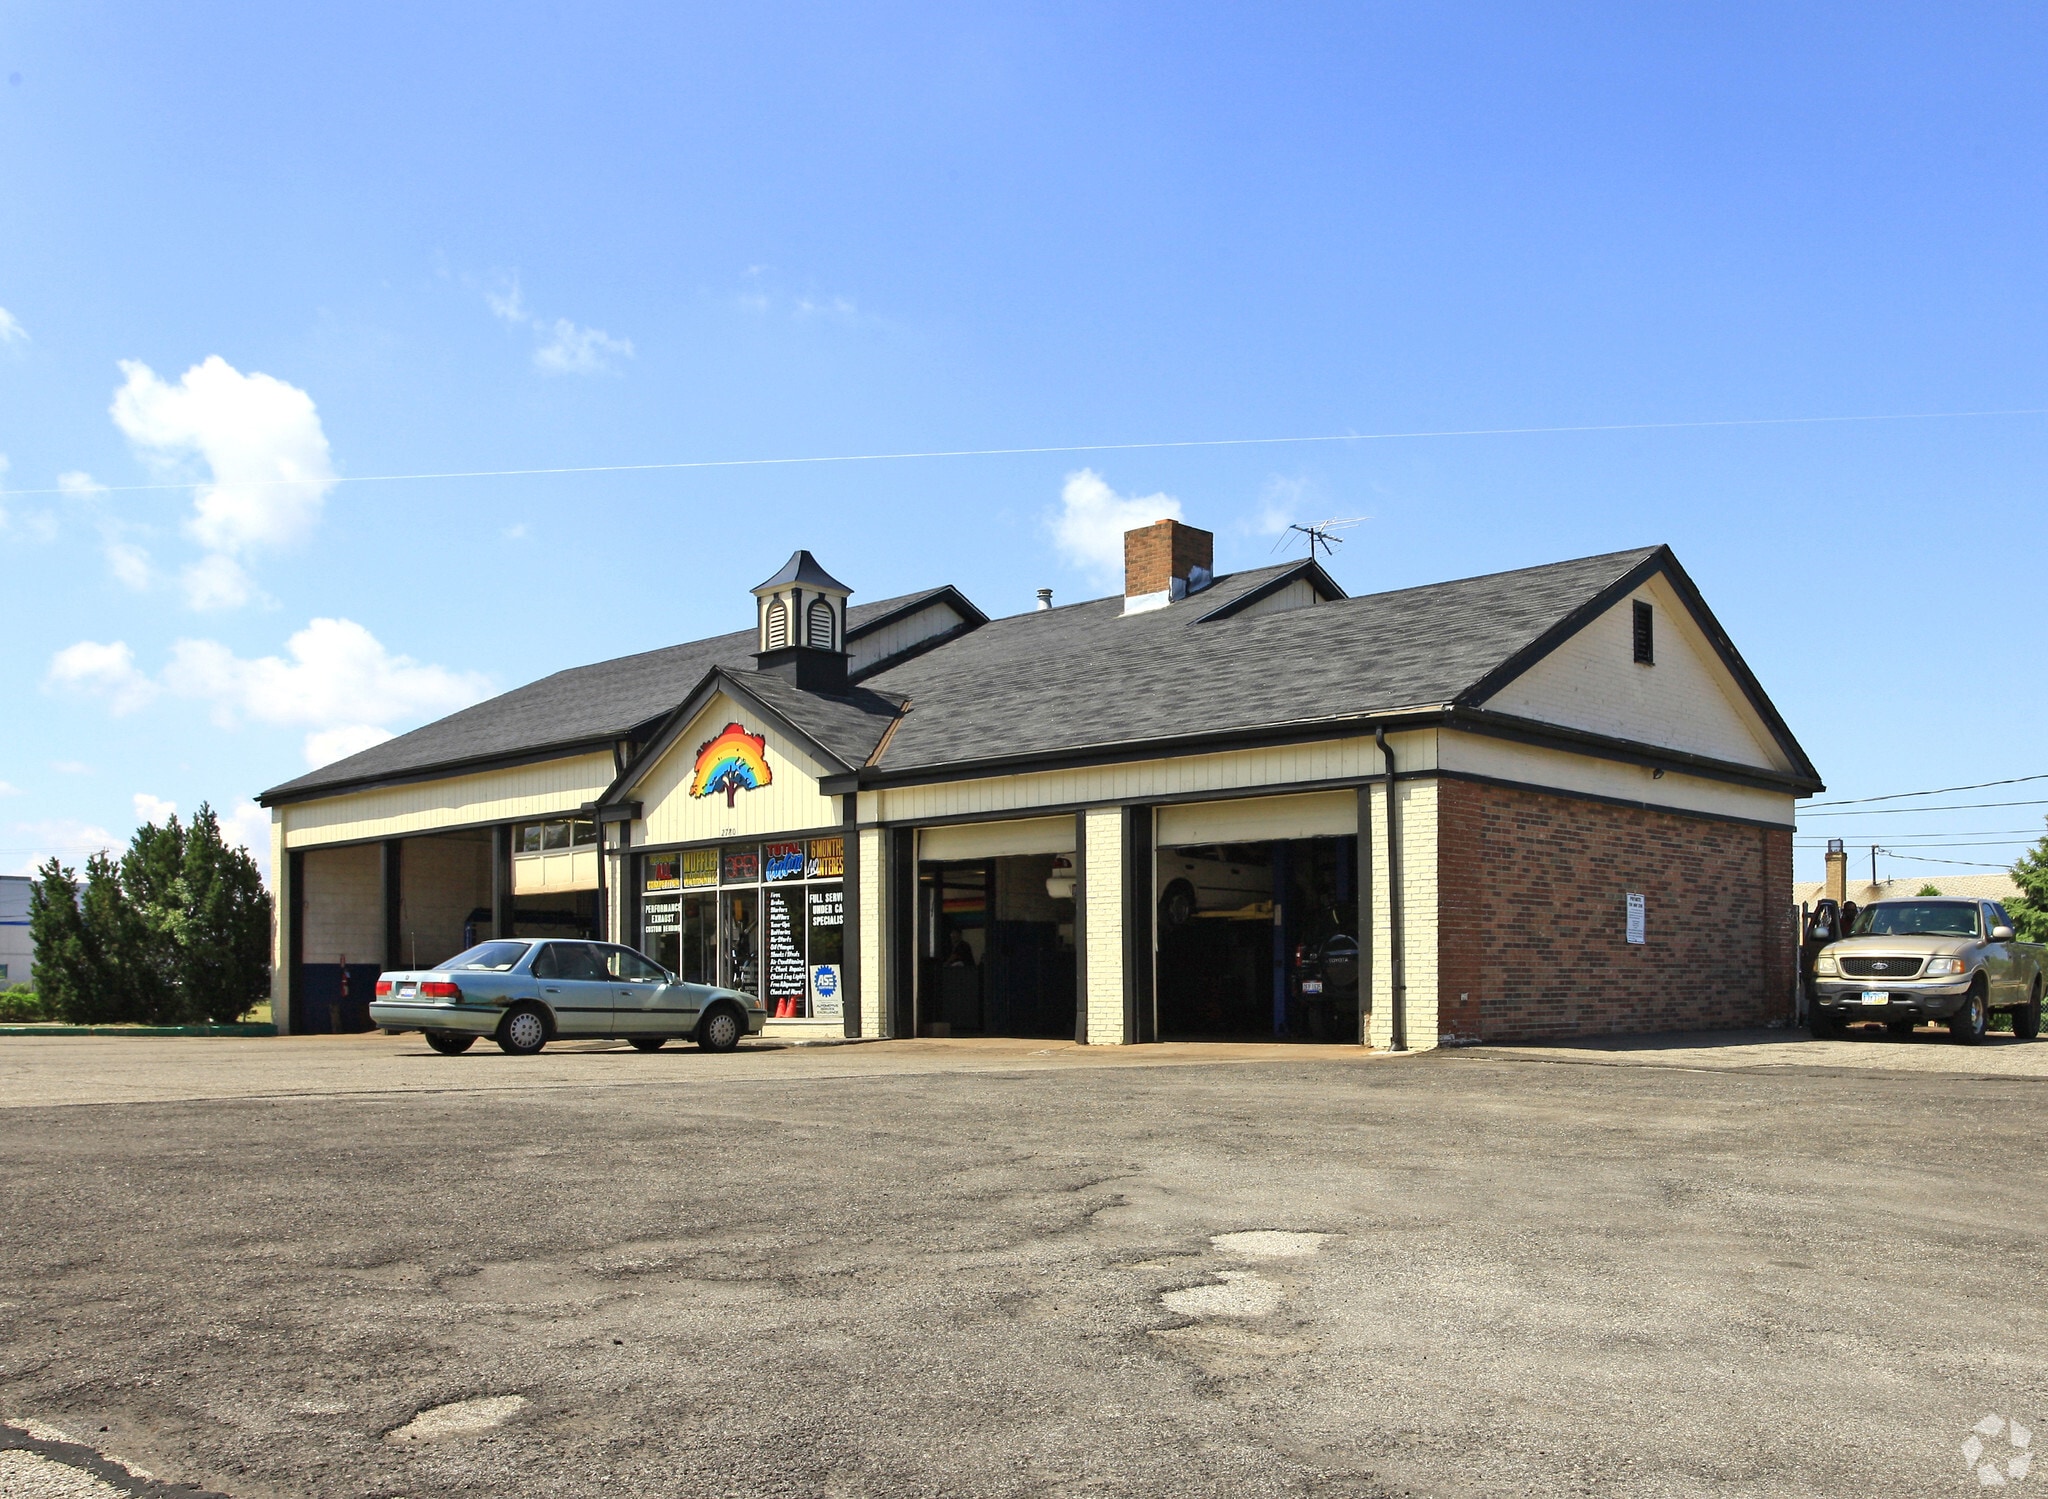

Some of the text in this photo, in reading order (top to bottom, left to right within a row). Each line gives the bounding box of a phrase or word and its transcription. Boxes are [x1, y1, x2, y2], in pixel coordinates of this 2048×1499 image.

[766, 842, 802, 858] TOTAL
[725, 853, 758, 879] OPEN
[809, 892, 843, 904] FULL SERVI
[812, 903, 843, 915] UNDER CA
[651, 914, 674, 923] EXHAUST
[812, 915, 844, 926] SPECIALIS
[817, 974, 834, 986] ASE
